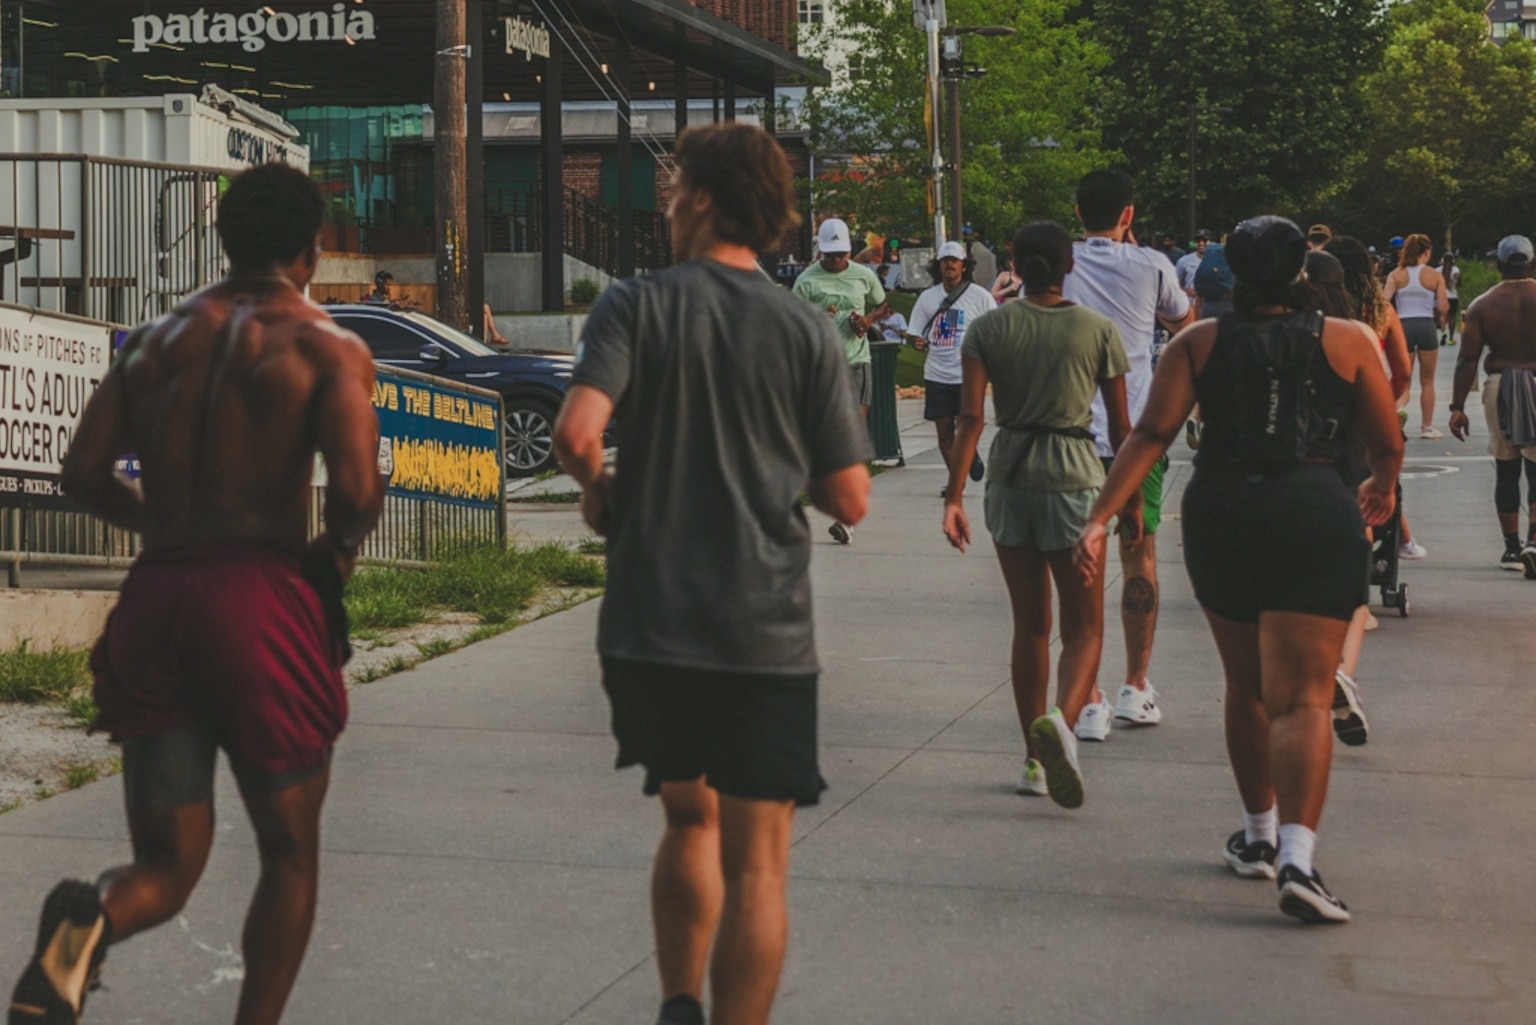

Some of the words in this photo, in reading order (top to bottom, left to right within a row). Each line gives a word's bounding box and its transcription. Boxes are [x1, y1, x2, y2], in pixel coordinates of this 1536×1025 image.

[132, 3, 376, 53] patagonia
[504, 14, 551, 62] patagonia
[23, 334, 33, 352] OF
[37, 333, 86, 366] PITCHES
[90, 345, 102, 365] FC
[370, 380, 399, 411] AVE
[402, 385, 432, 417] THE
[433, 392, 496, 431] BELTLINE
[23, 478, 52, 496] PICKUPS
